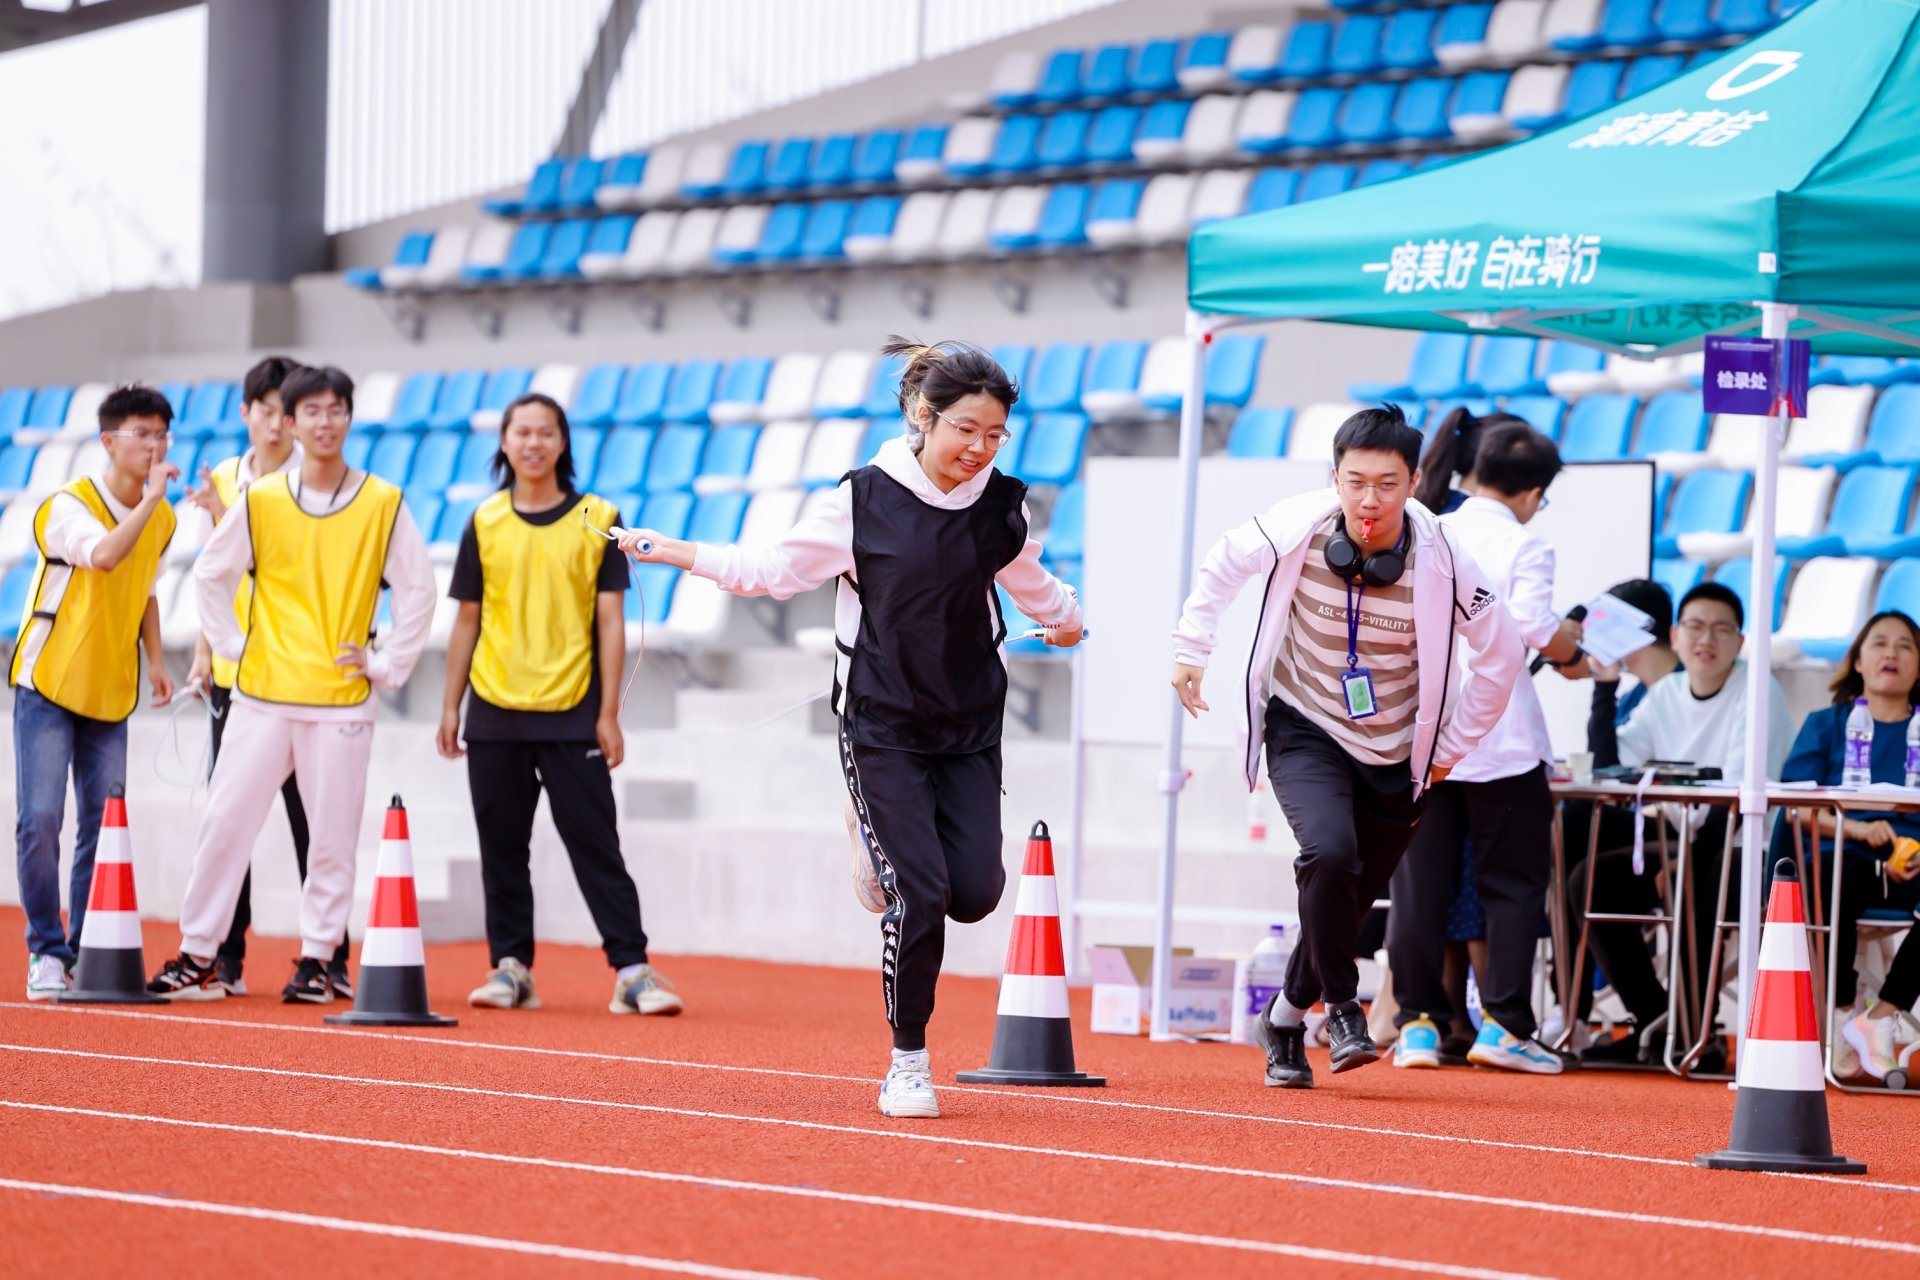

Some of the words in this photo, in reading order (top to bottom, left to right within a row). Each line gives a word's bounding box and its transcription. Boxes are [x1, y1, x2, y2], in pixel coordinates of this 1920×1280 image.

[1361, 239, 1480, 293] 一路美好
[1481, 233, 1601, 290] 自在骑行
[1717, 370, 1767, 390] 检录处
[1317, 604, 1410, 632] ASL-45-VITALITY
